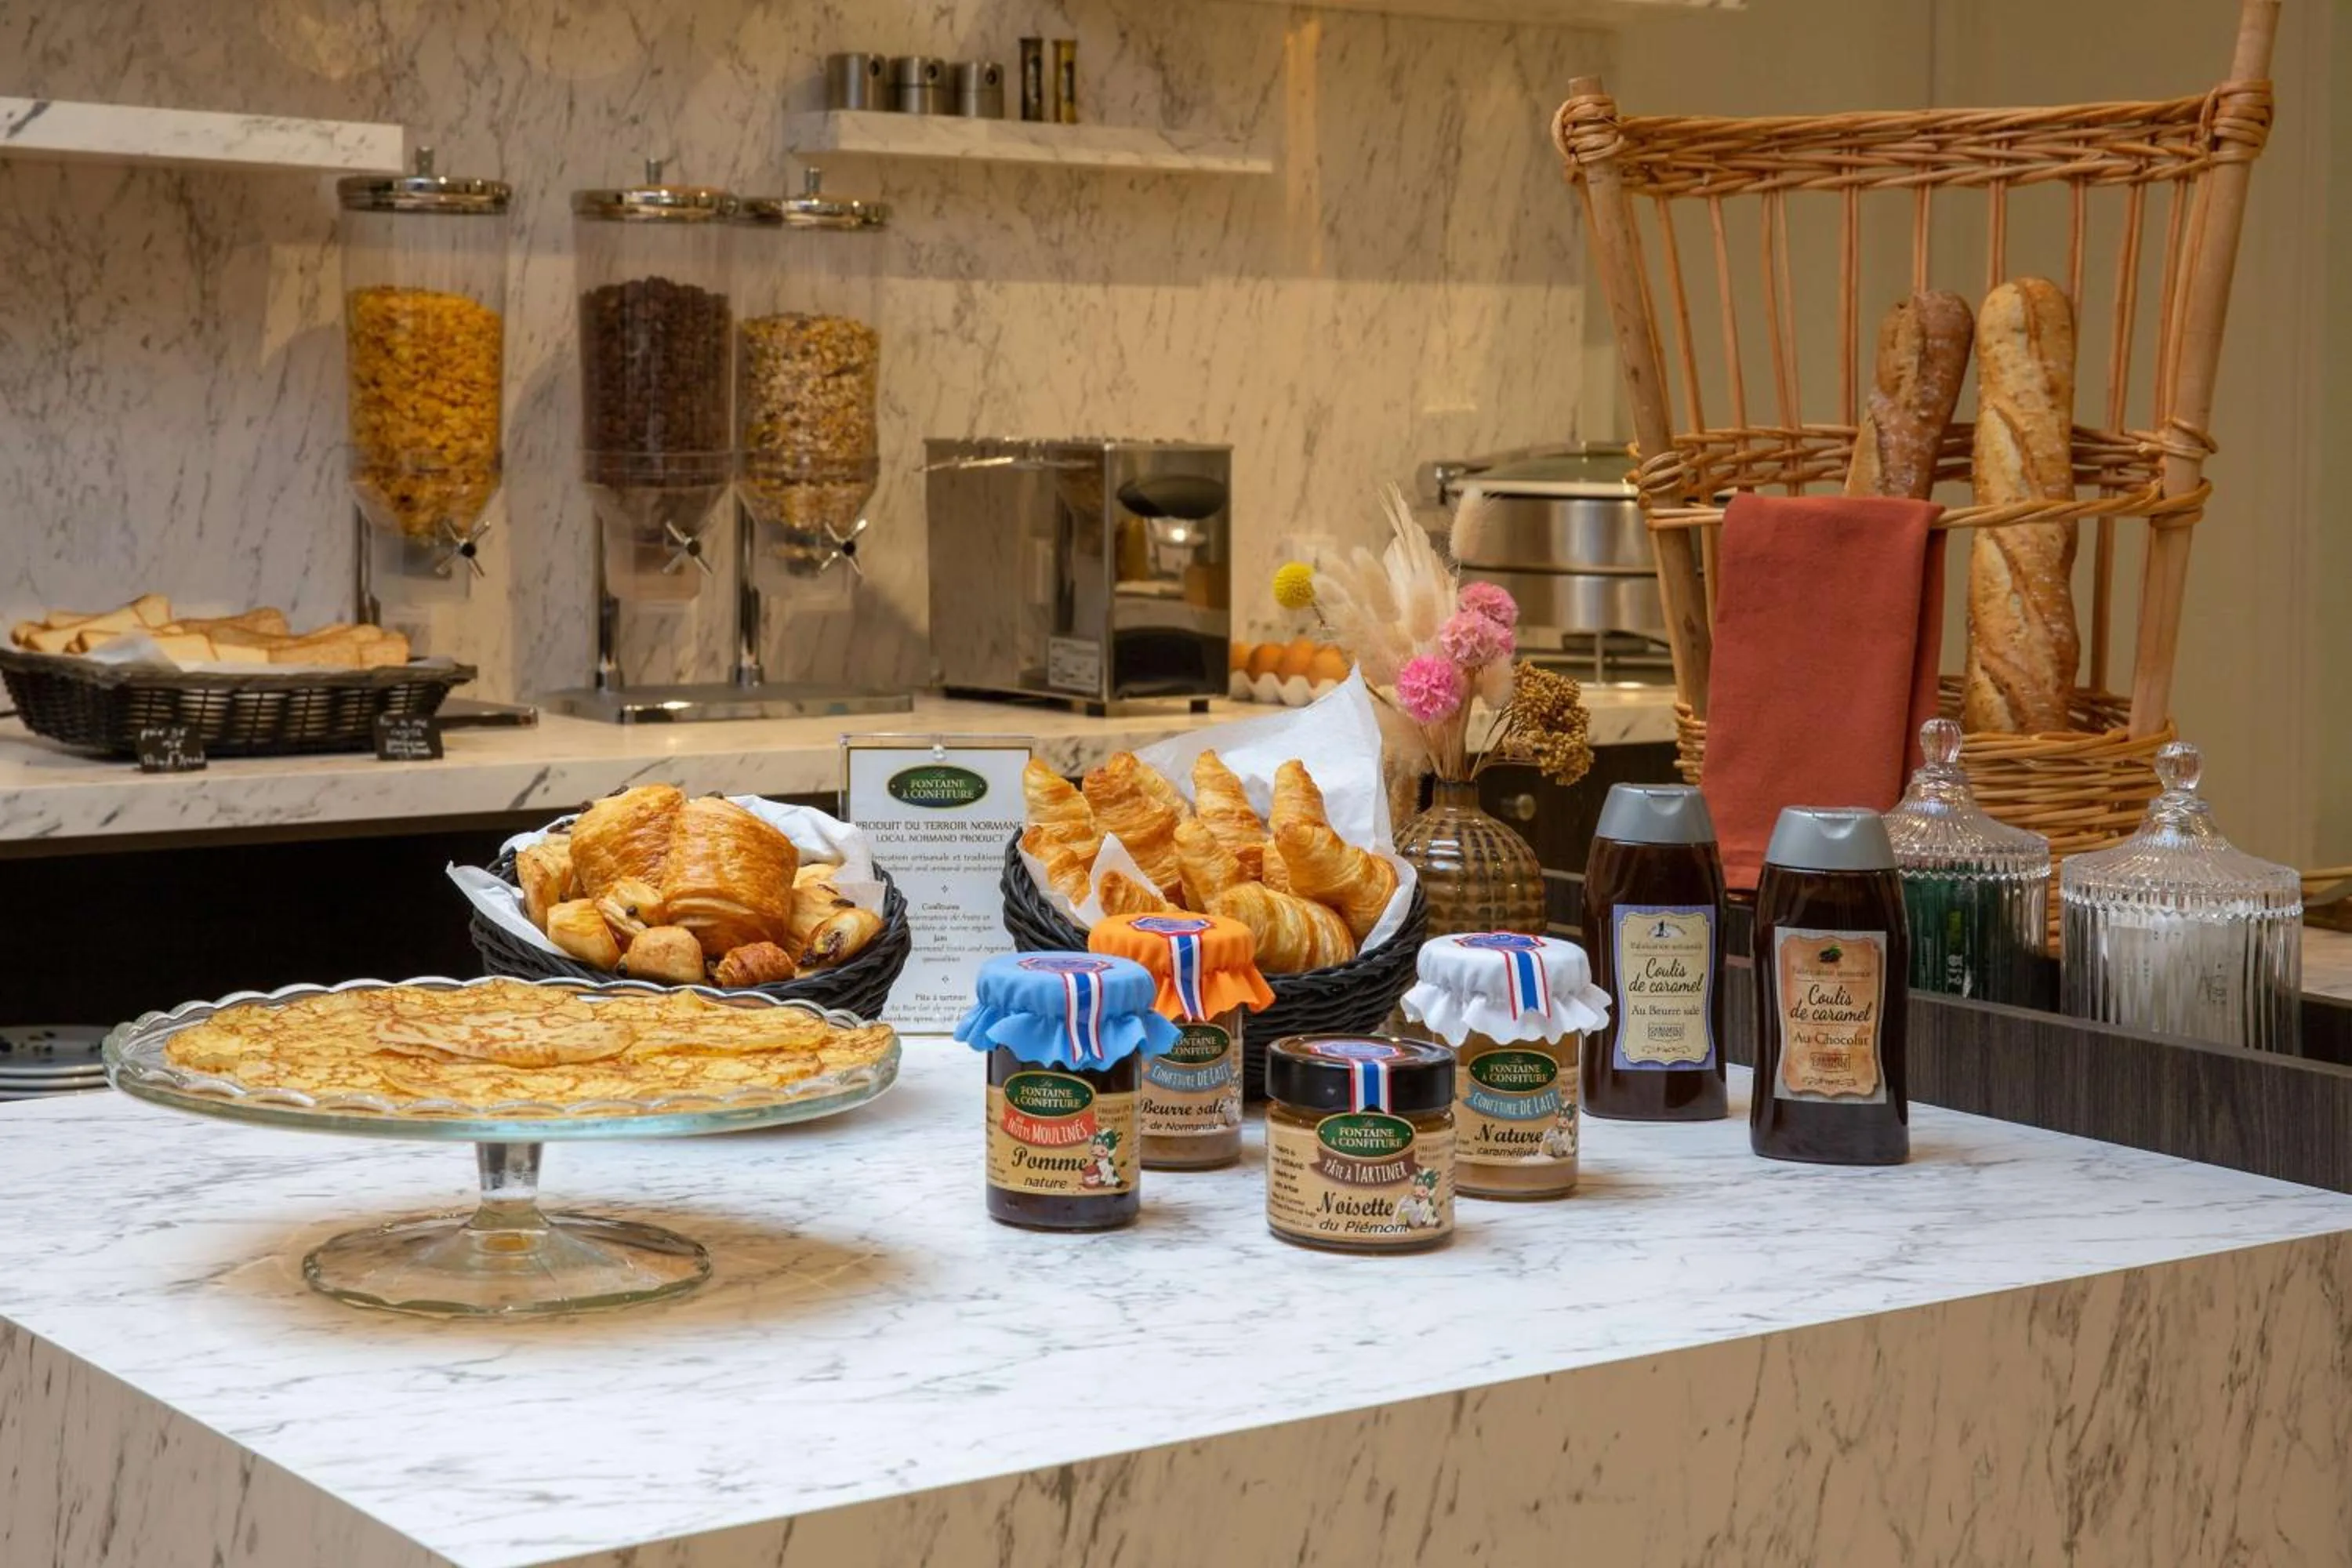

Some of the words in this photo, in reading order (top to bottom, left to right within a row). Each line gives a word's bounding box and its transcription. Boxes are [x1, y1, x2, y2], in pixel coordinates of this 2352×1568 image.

[910, 779, 967, 789] FONTAINE
[910, 789, 975, 799] CONFITURE
[855, 821, 900, 830] PRODUIT
[905, 821, 920, 830] DU
[924, 821, 967, 830] TERROIR
[876, 834, 905, 843] LOCAL
[909, 834, 957, 843] NORMAND
[960, 834, 1004, 843] PRODUCT
[1645, 956, 1687, 979] Coulis
[1628, 972, 1645, 993] de
[1649, 973, 1704, 993] caramel
[1808, 984, 1853, 1006] Coulis
[1631, 1005, 1646, 1015] Au
[1649, 1004, 1681, 1015] Beurre
[1790, 997, 1808, 1020] de
[1812, 1001, 1872, 1022] caramel
[1177, 1036, 1218, 1046] ONTAINE
[1793, 1032, 1810, 1044] Au
[1815, 1031, 1869, 1046] Chocolat
[1152, 1064, 1196, 1087] CONFITURE
[1197, 1071, 1208, 1087] DE
[1210, 1063, 1230, 1085] LAIT
[1490, 1064, 1541, 1074] FONTAINE
[1489, 1073, 1550, 1083] CONFITURE
[1020, 1085, 1073, 1098] FONTAINE
[1020, 1096, 1081, 1109] CONFITURE
[1141, 1098, 1193, 1116] Beurre
[1473, 1091, 1517, 1116] CONFITURE
[1519, 1098, 1532, 1116] DE
[1534, 1091, 1556, 1114] LAIT
[1031, 1118, 1088, 1144] MOULINÉS
[1150, 1120, 1163, 1129] de
[1338, 1127, 1395, 1138] FONTAINE
[1474, 1123, 1544, 1144] Nature
[1338, 1138, 1403, 1148] CONFITURE
[1011, 1146, 1088, 1171] Pomme
[1323, 1158, 1345, 1179] PÂTE
[1355, 1160, 1408, 1184] TARTINER
[1023, 1177, 1068, 1189] nature
[1316, 1191, 1394, 1216] Noisette
[1319, 1219, 1340, 1232] du
[1344, 1220, 1408, 1234] Piémont
